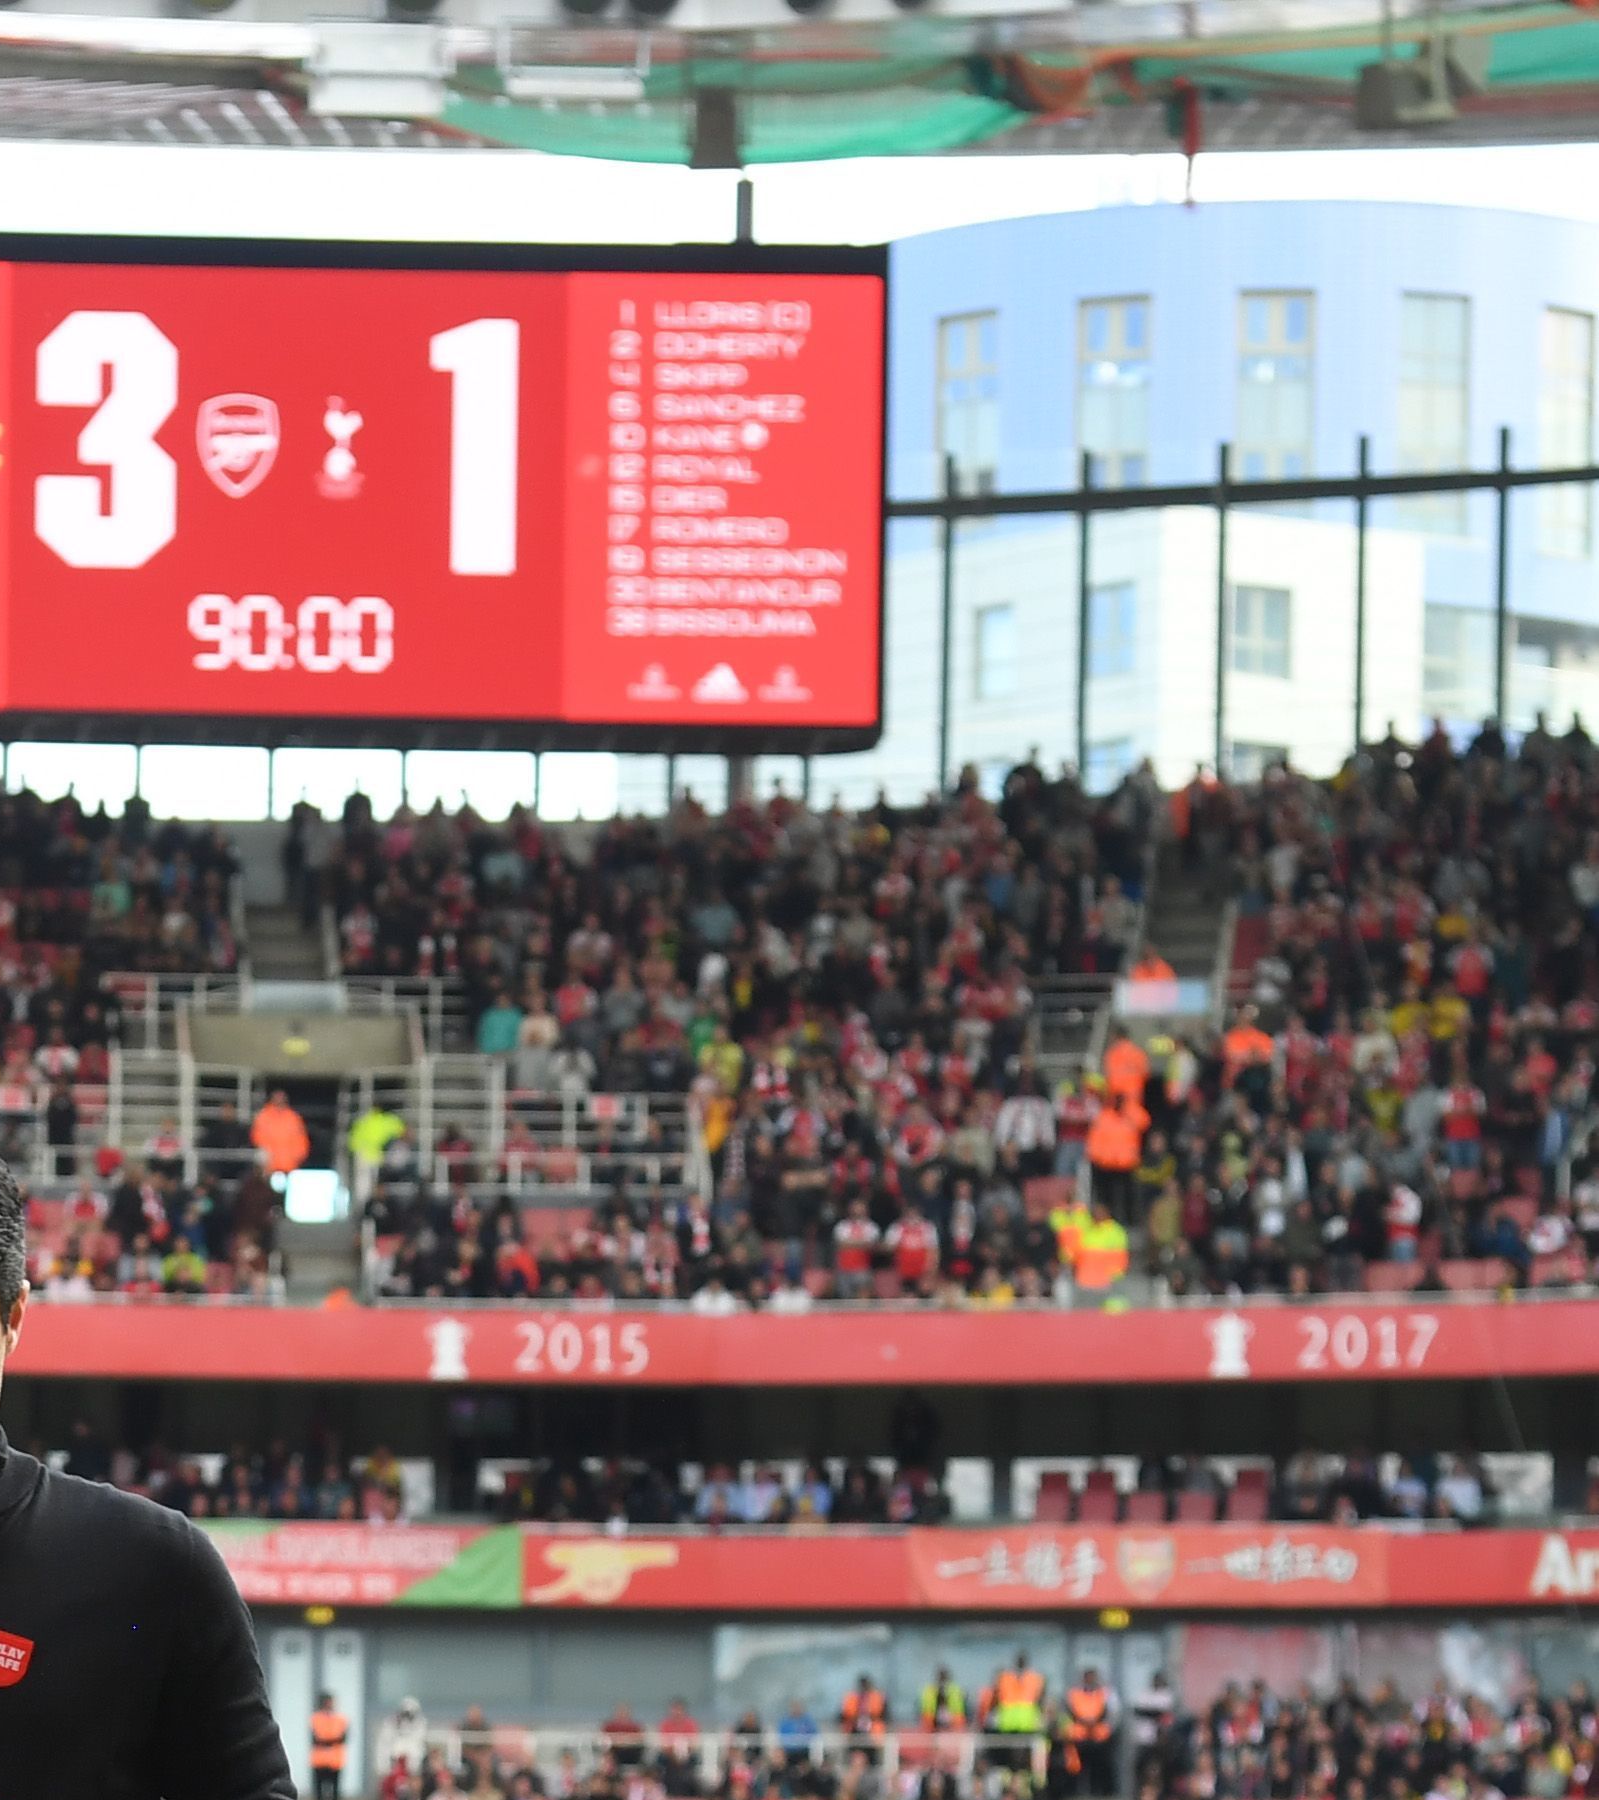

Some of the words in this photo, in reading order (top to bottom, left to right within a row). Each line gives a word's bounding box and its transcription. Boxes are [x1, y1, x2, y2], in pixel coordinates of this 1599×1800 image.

[610, 330, 642, 359] 2
[35, 310, 178, 569] 3
[430, 318, 519, 576] 1
[187, 593, 395, 674] 90:00
[513, 1321, 651, 1376] 2015
[1298, 1313, 1440, 1370] 2017
